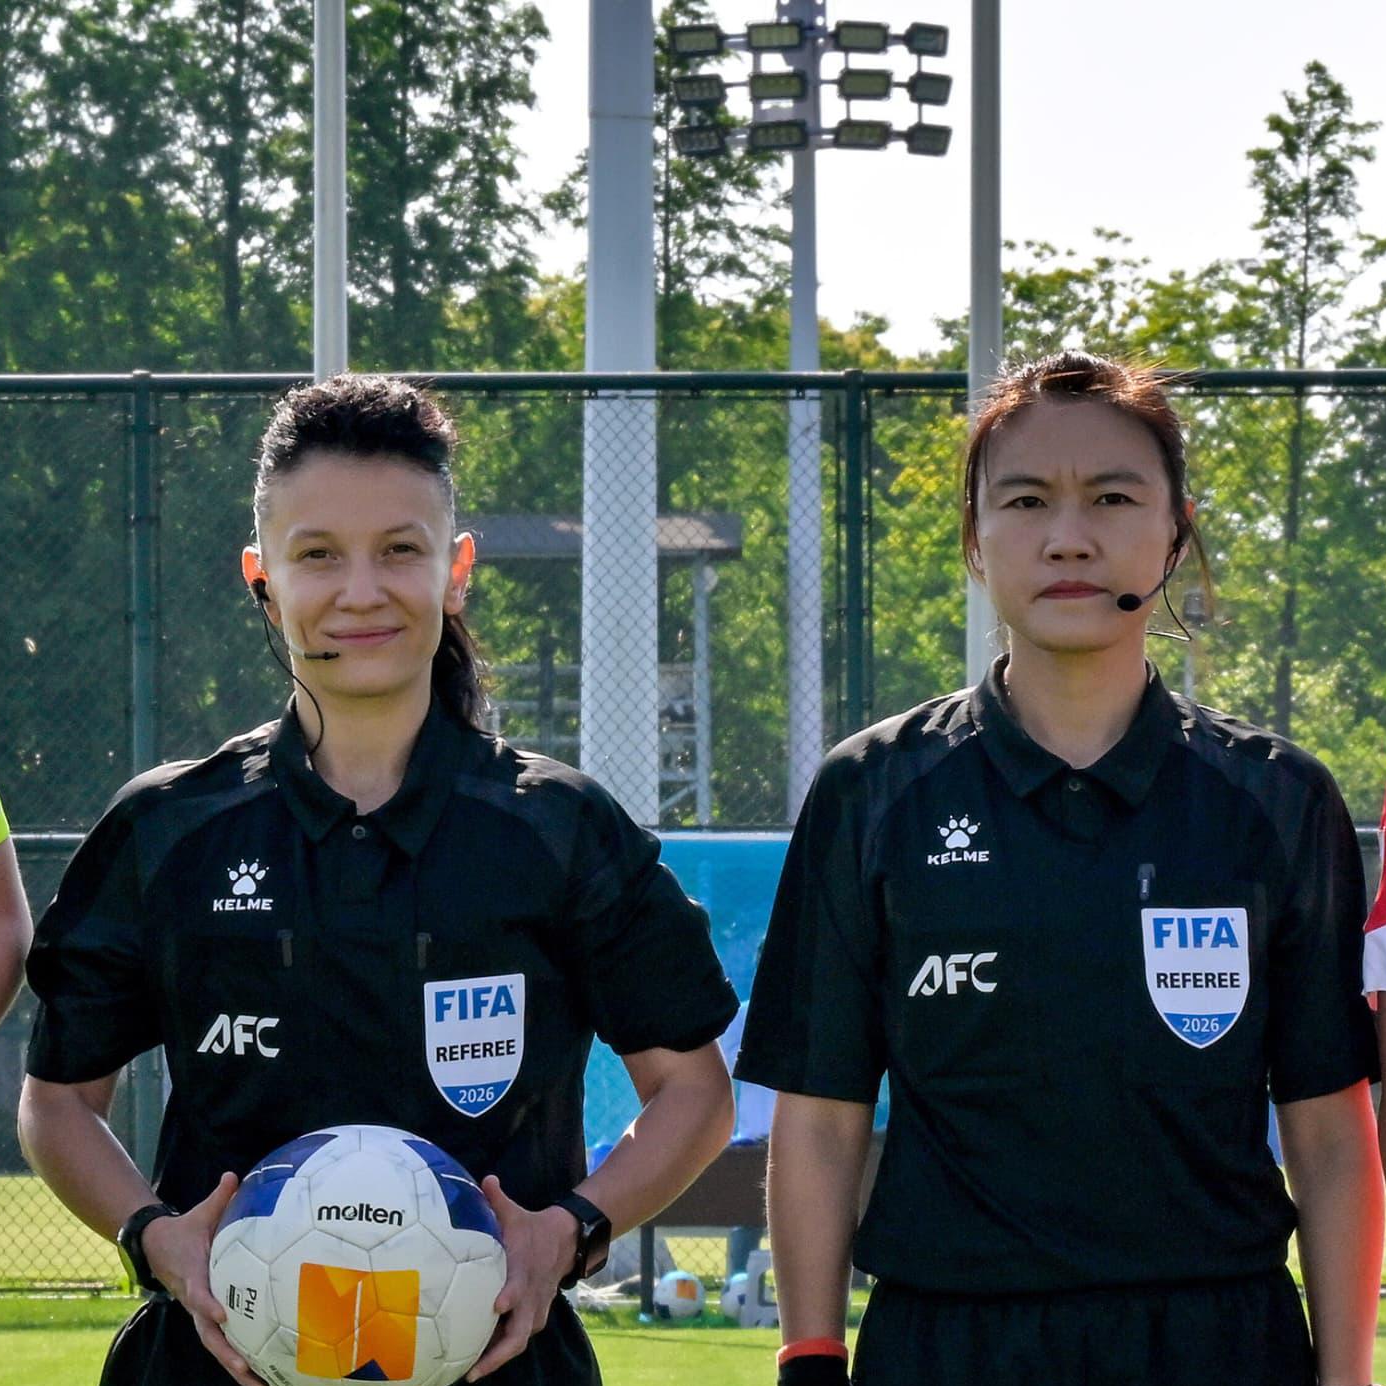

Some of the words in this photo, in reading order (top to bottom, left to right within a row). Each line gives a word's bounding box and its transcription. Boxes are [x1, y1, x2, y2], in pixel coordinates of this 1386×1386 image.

[927, 850, 990, 866] KELME
[213, 899, 274, 912] KELME
[1152, 917, 1239, 949] FIFA
[908, 952, 998, 997] AFC
[1156, 972, 1241, 989] REFEREE
[434, 985, 517, 1023] FIFA
[197, 1013, 281, 1059] AFC
[1181, 1018, 1220, 1034] 2026
[436, 1039, 517, 1063] REFEREE
[458, 1087, 495, 1104] 2026
[317, 1203, 404, 1227] molten
